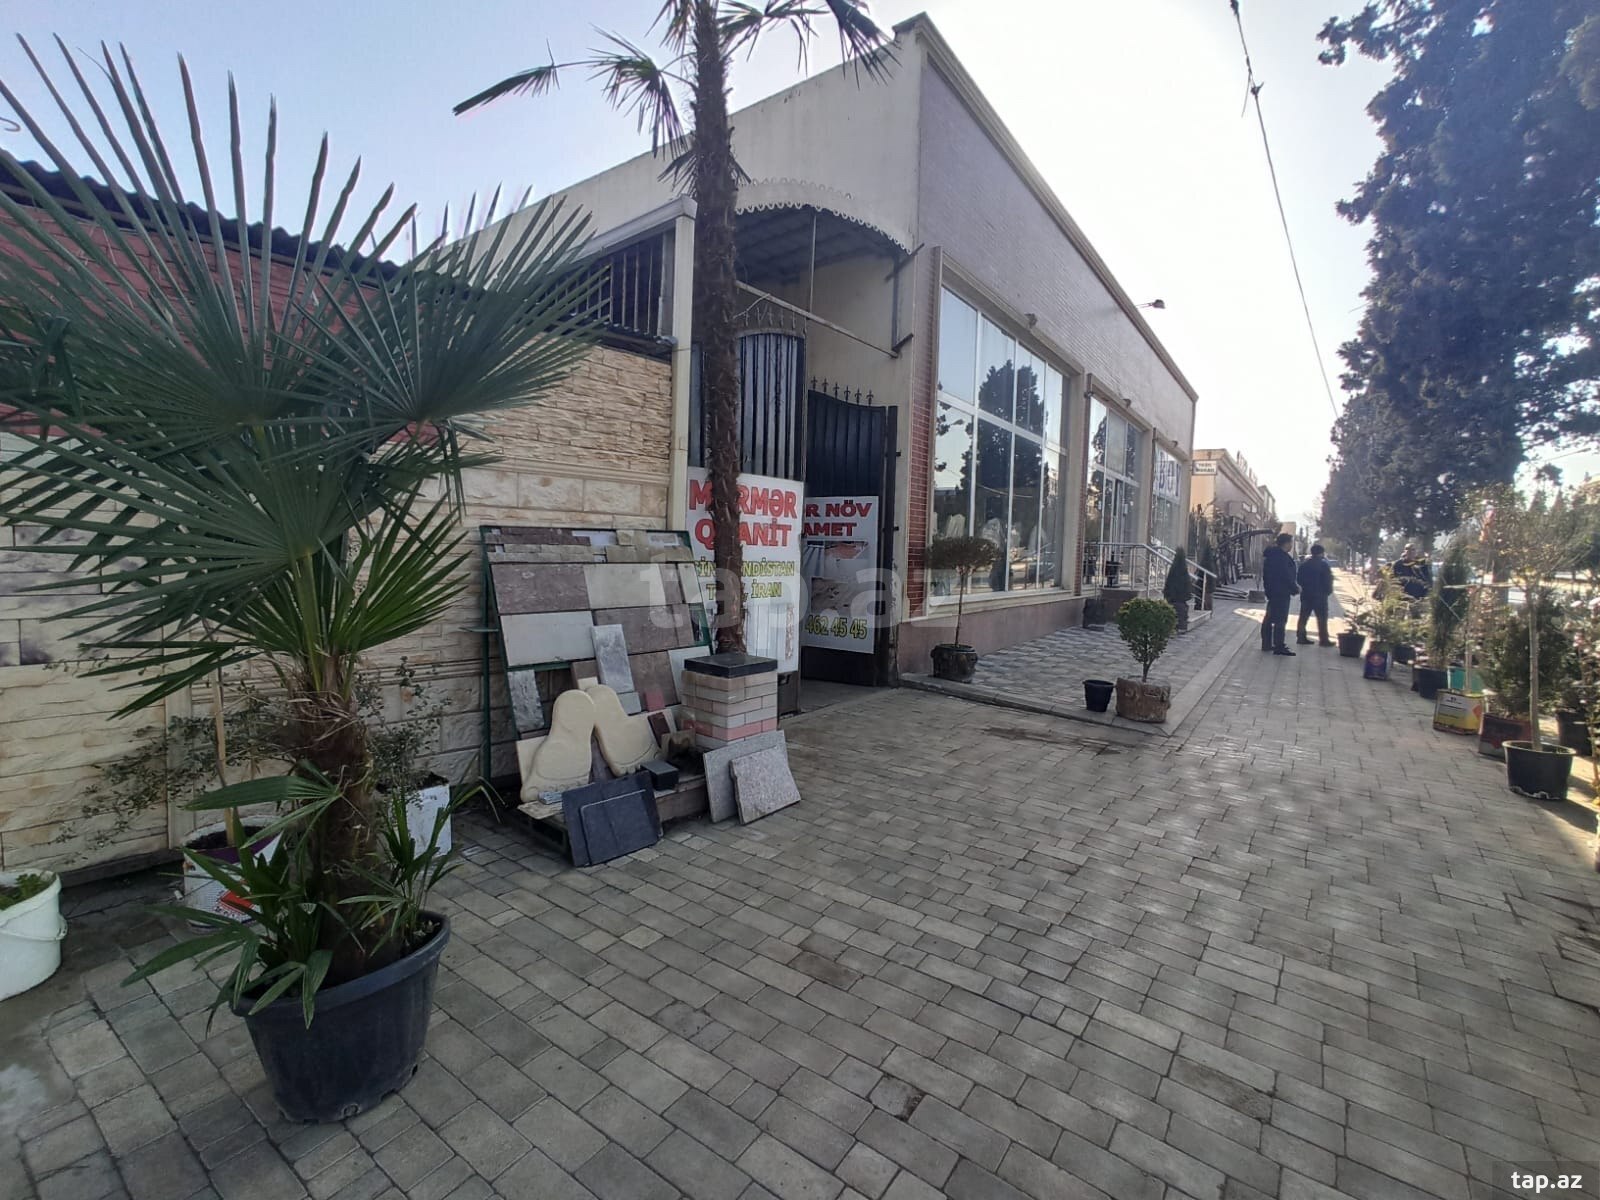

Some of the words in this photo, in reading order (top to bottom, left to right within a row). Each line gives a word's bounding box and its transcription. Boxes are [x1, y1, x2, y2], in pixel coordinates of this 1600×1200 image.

[689, 479, 798, 519] MRMƏR
[825, 499, 873, 517] NÖV
[695, 518, 792, 550] QANİT
[803, 522, 857, 537] AMET
[741, 557, 796, 577] NDİSTAN
[751, 579, 782, 598] İRAN
[831, 616, 848, 637] 45
[850, 618, 868, 639] 45
